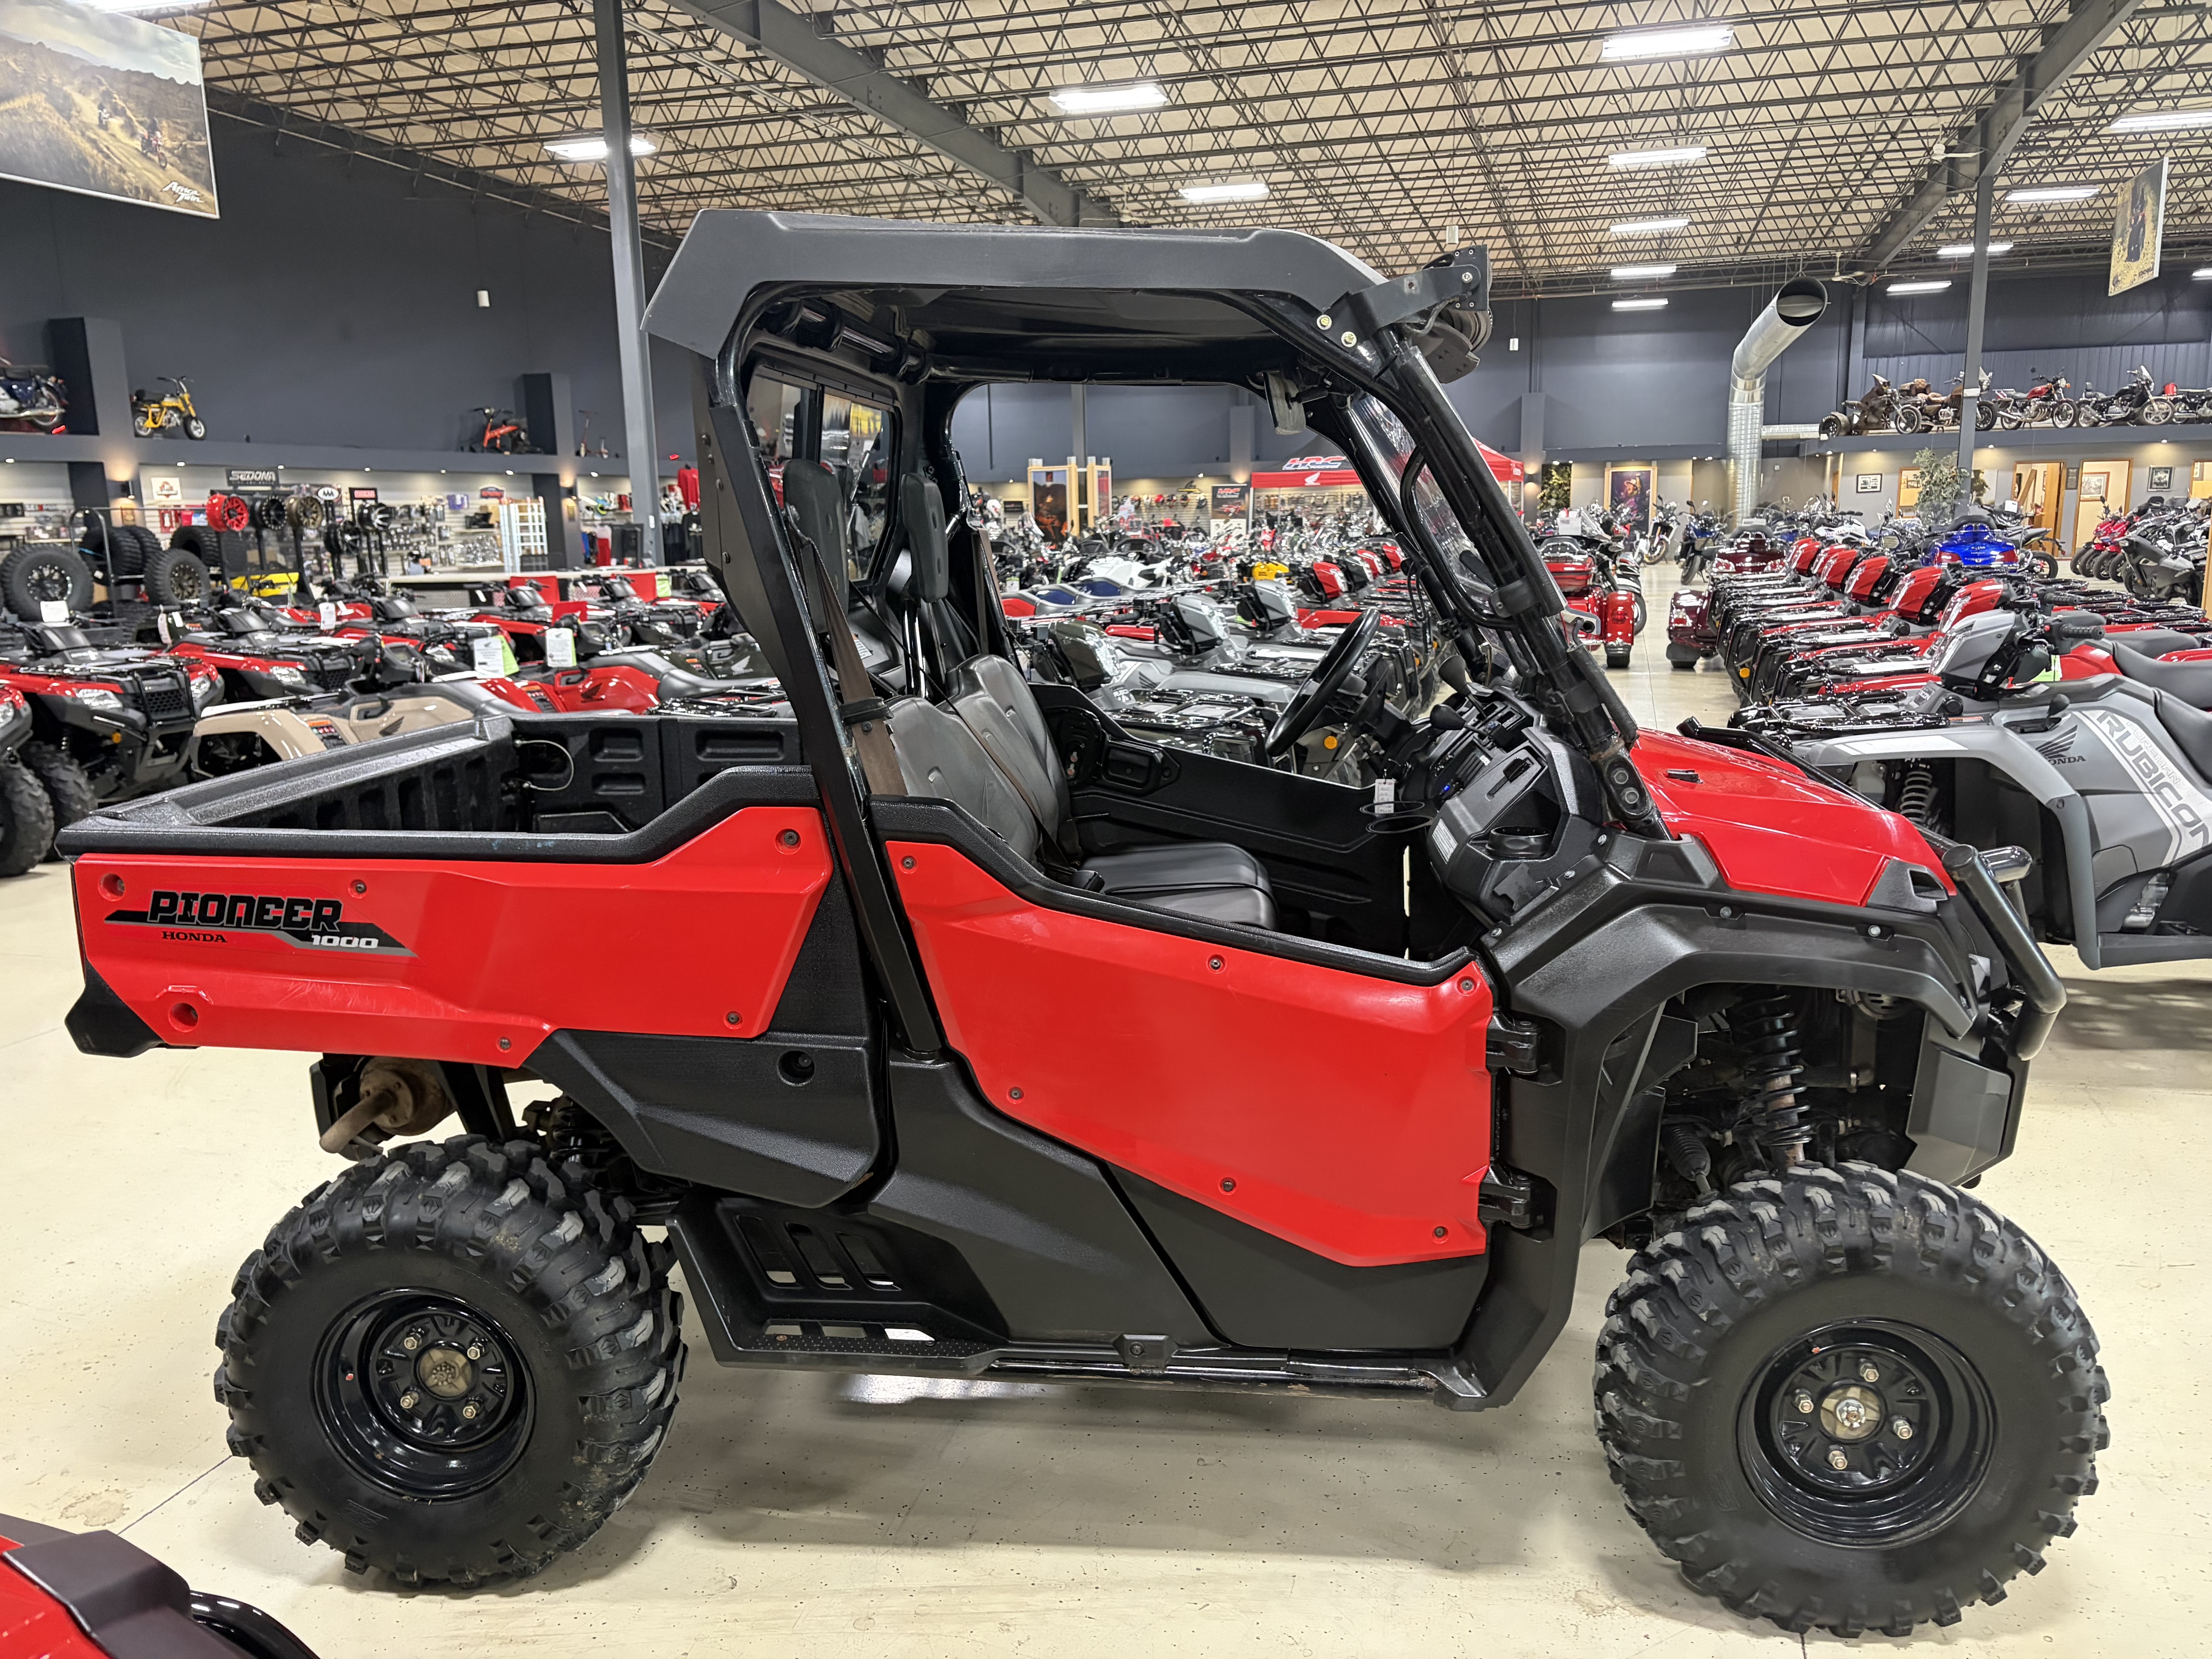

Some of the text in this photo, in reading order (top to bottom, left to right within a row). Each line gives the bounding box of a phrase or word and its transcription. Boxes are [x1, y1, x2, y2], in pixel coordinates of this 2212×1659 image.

[162, 181, 201, 196] Africa
[176, 192, 205, 203] Twin
[1283, 456, 1347, 469] HRC
[229, 470, 276, 481] SEDONA
[2126, 721, 2181, 785] FOREMAN
[2047, 756, 2086, 765] ONDA
[2096, 711, 2209, 848] RUBICON
[147, 890, 343, 932] PIONEER
[162, 931, 228, 943] HONDA
[311, 934, 379, 949] 1000
